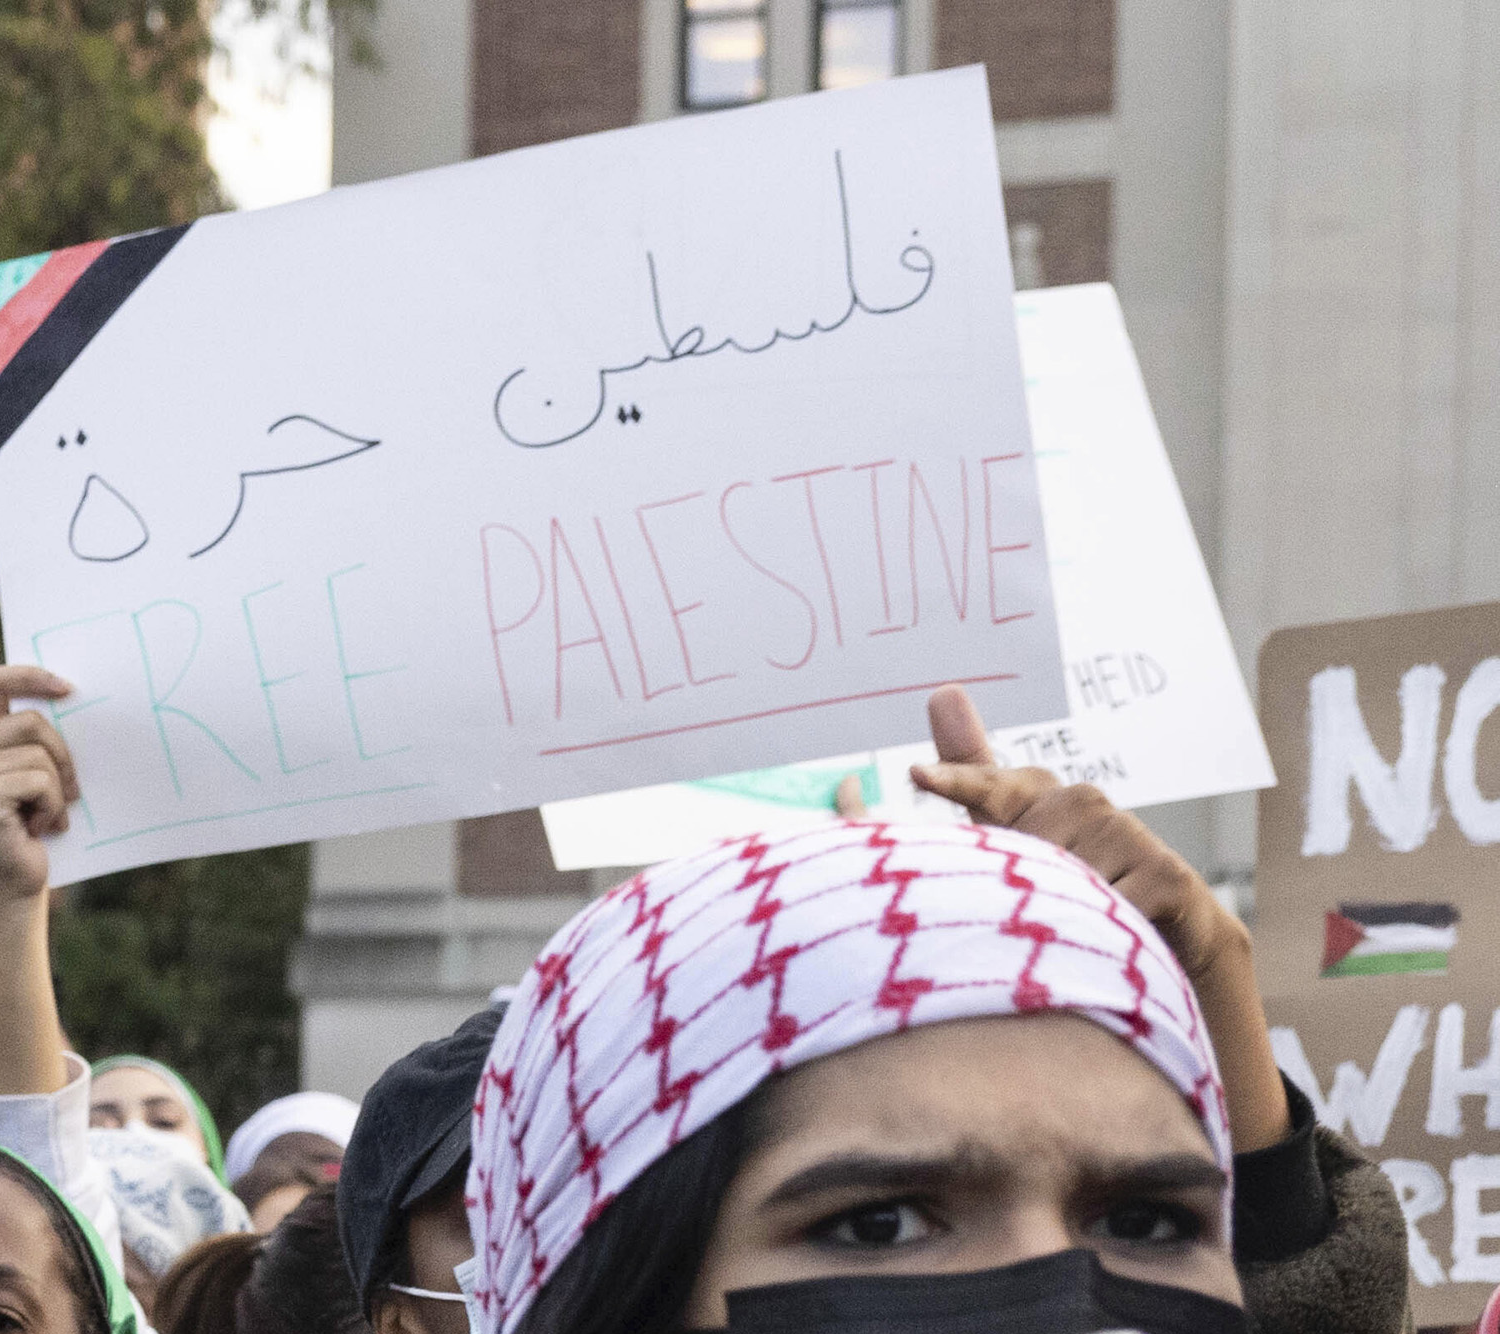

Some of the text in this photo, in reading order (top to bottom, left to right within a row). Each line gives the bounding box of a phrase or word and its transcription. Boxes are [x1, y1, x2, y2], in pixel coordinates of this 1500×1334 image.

[55, 148, 936, 563] فلسطين حرة
[31, 453, 1036, 834] FREE PALESTINE
[1069, 652, 1168, 710] HEID
